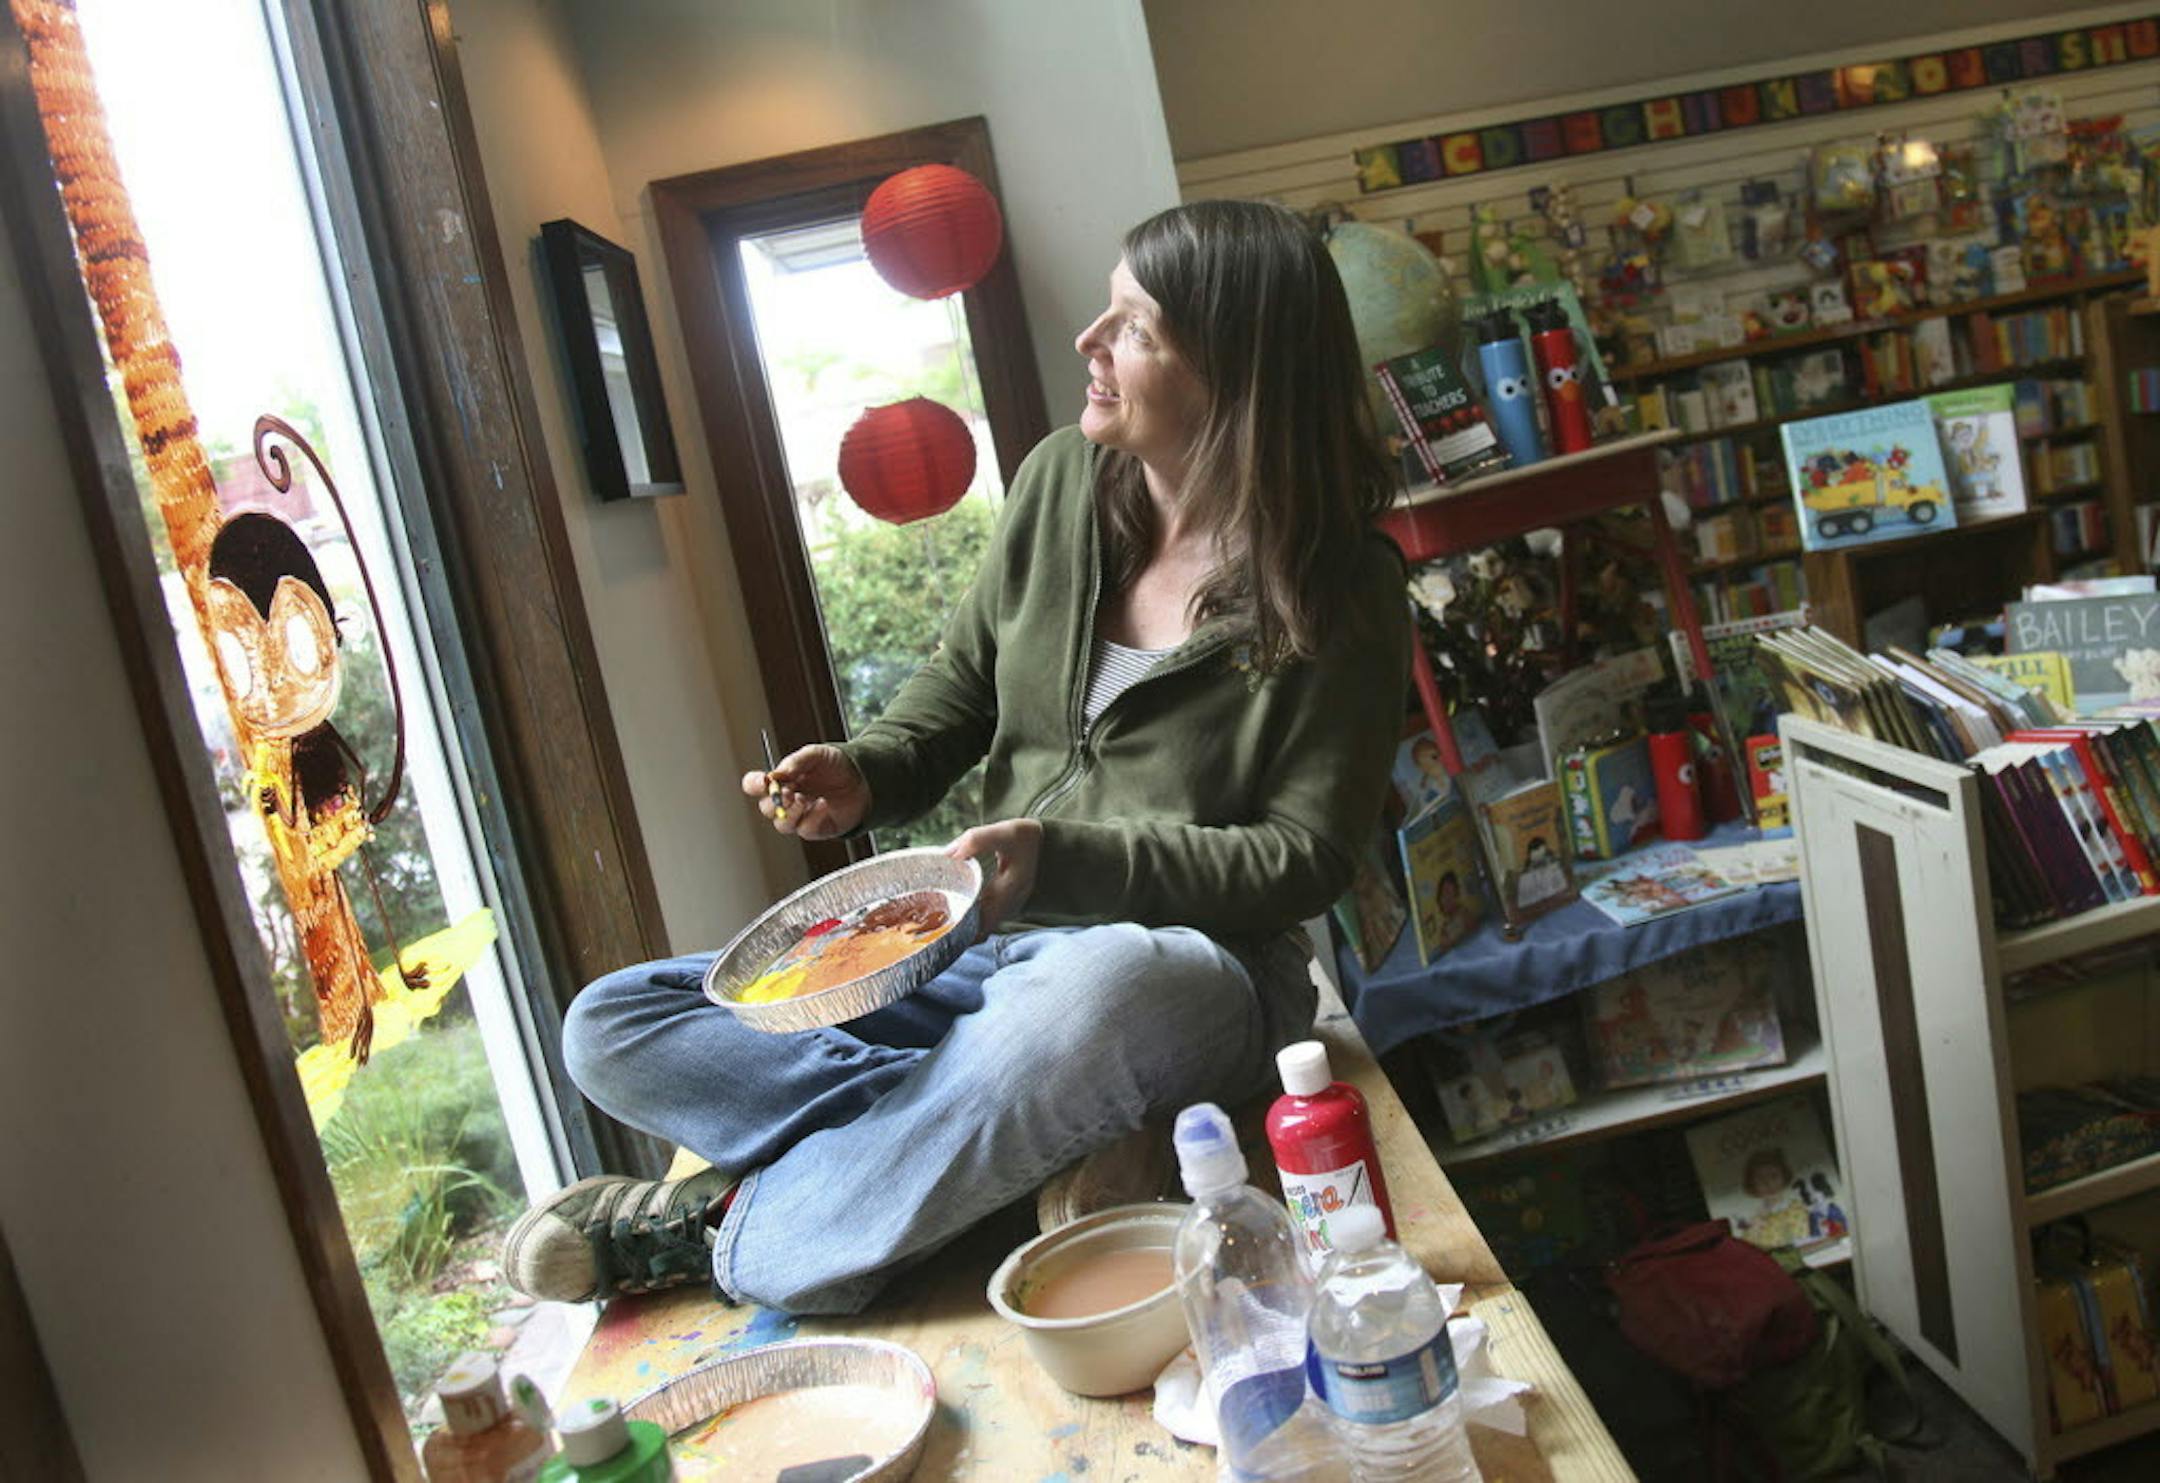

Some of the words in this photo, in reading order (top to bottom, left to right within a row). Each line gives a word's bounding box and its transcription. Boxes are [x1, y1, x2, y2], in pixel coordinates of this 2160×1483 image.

[1412, 388, 1468, 417] TEACHERS
[1422, 384, 1438, 399] TO
[2016, 603, 2160, 650] BAILEY
